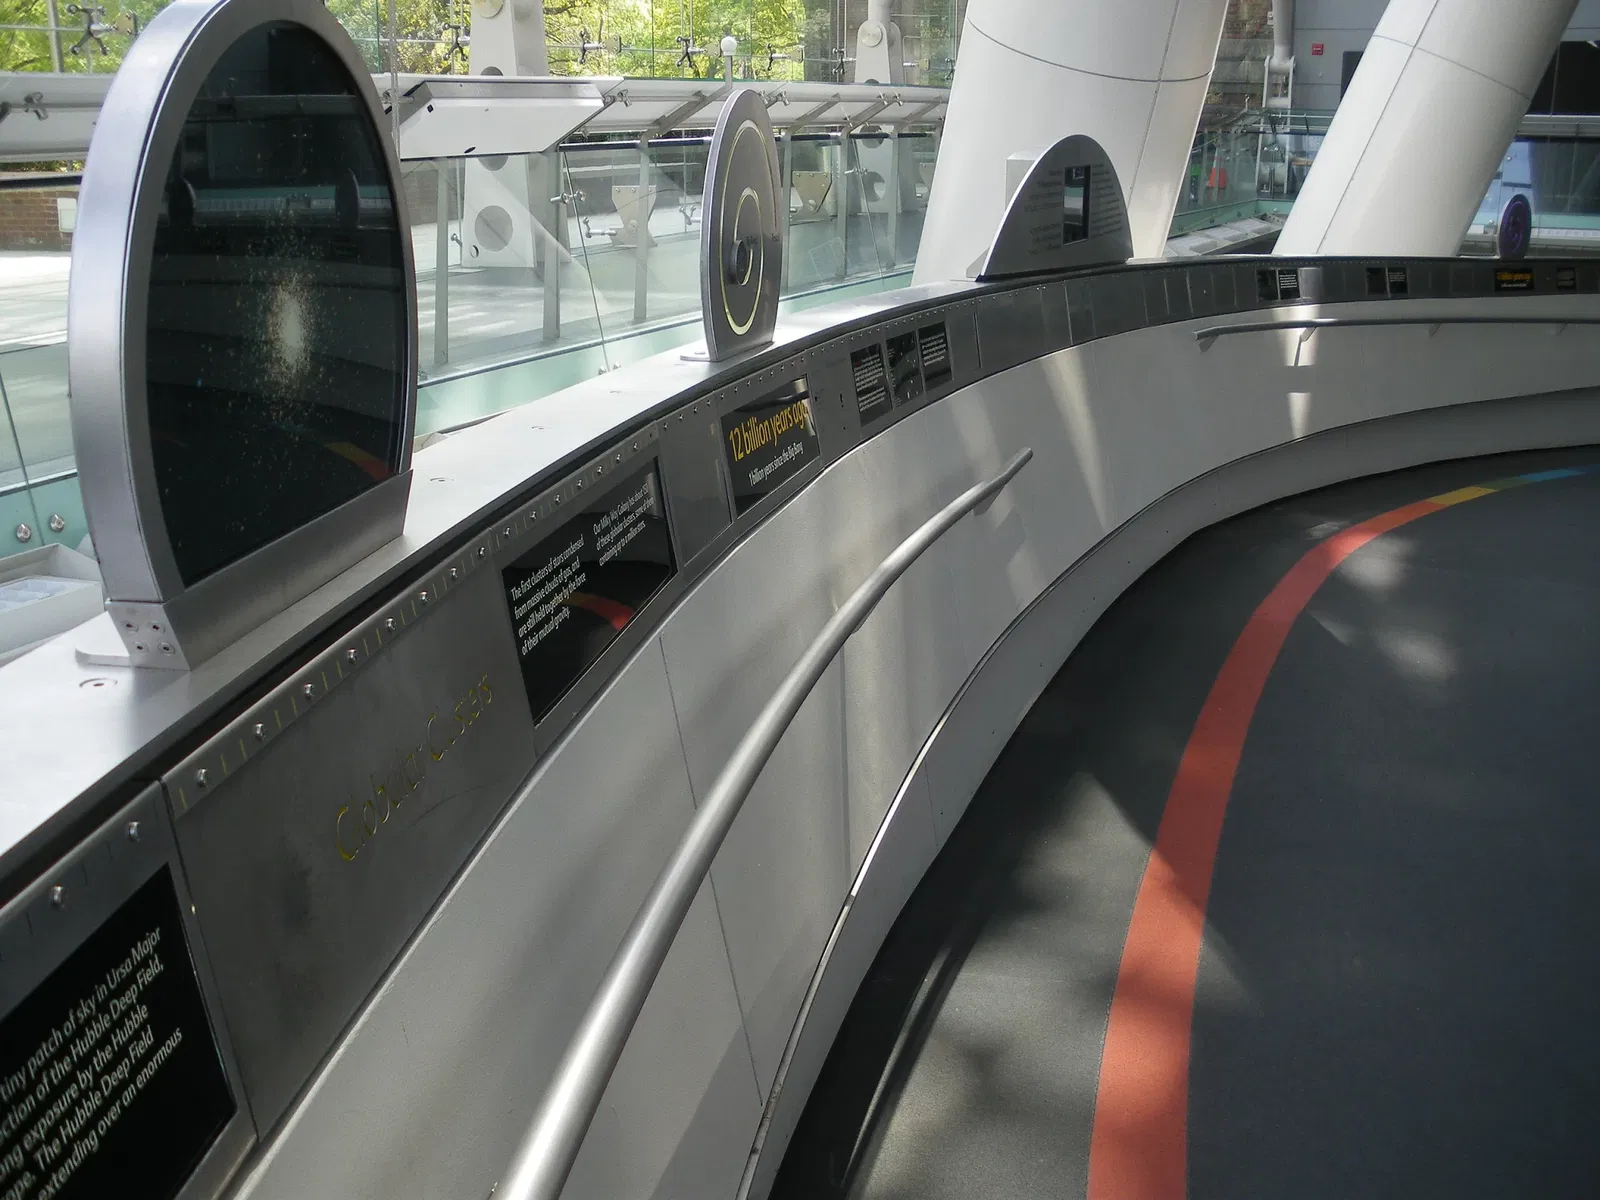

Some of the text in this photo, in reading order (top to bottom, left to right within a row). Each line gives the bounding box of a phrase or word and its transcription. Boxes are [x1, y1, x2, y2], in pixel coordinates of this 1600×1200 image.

[729, 400, 809, 462] 12 billion years ago
[511, 533, 584, 601] The first clusters of stars condensed
[514, 603, 528, 620] from
[526, 588, 545, 610] massive
[544, 575, 559, 595] clouds
[558, 568, 564, 583] of
[571, 555, 581, 572] and
[518, 572, 586, 638] are still held together by the force
[521, 639, 528, 656] of
[527, 632, 539, 650] their
[538, 615, 555, 641] mutual
[0, 926, 161, 1102] tiny patch of sky in Ursa Major
[36, 1071, 50, 1101] of
[50, 1055, 73, 1085] the
[69, 1012, 112, 1064] Hubble
[109, 983, 139, 1020] Deep
[136, 953, 165, 991] Field,
[22, 1083, 80, 1152] exposure
[76, 1064, 94, 1090] by
[93, 1044, 114, 1073] the
[111, 1003, 150, 1053] Hubble
[33, 1138, 61, 1171] The
[59, 1090, 104, 1145] Hubble
[100, 1057, 131, 1098] Deep
[128, 1023, 155, 1065] Field
[38, 1027, 183, 1200] extending over an enormous
